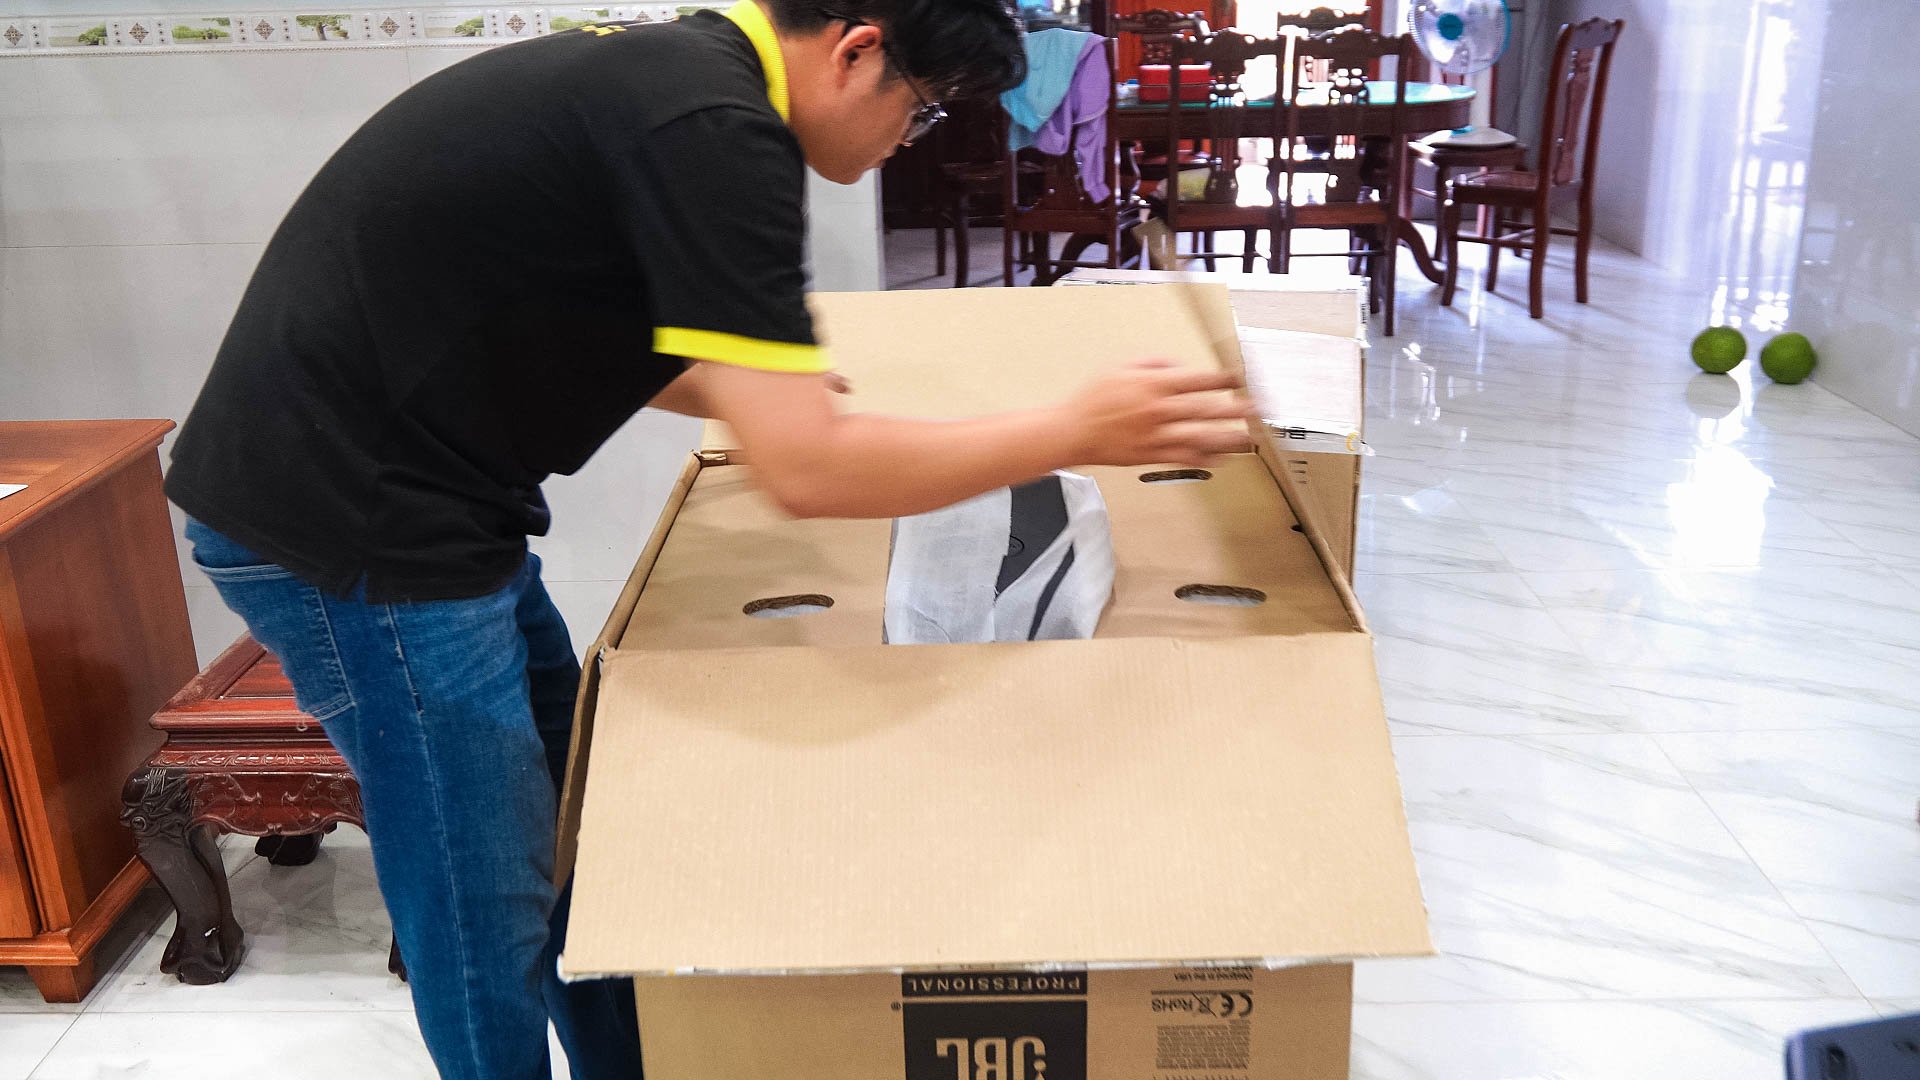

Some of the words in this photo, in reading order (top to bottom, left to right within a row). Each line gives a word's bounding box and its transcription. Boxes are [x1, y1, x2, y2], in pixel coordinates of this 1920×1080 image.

[908, 977, 1081, 992] PROFESSIONAL
[1151, 998, 1193, 1014] RoHS
[936, 1036, 1047, 1080] JBL
